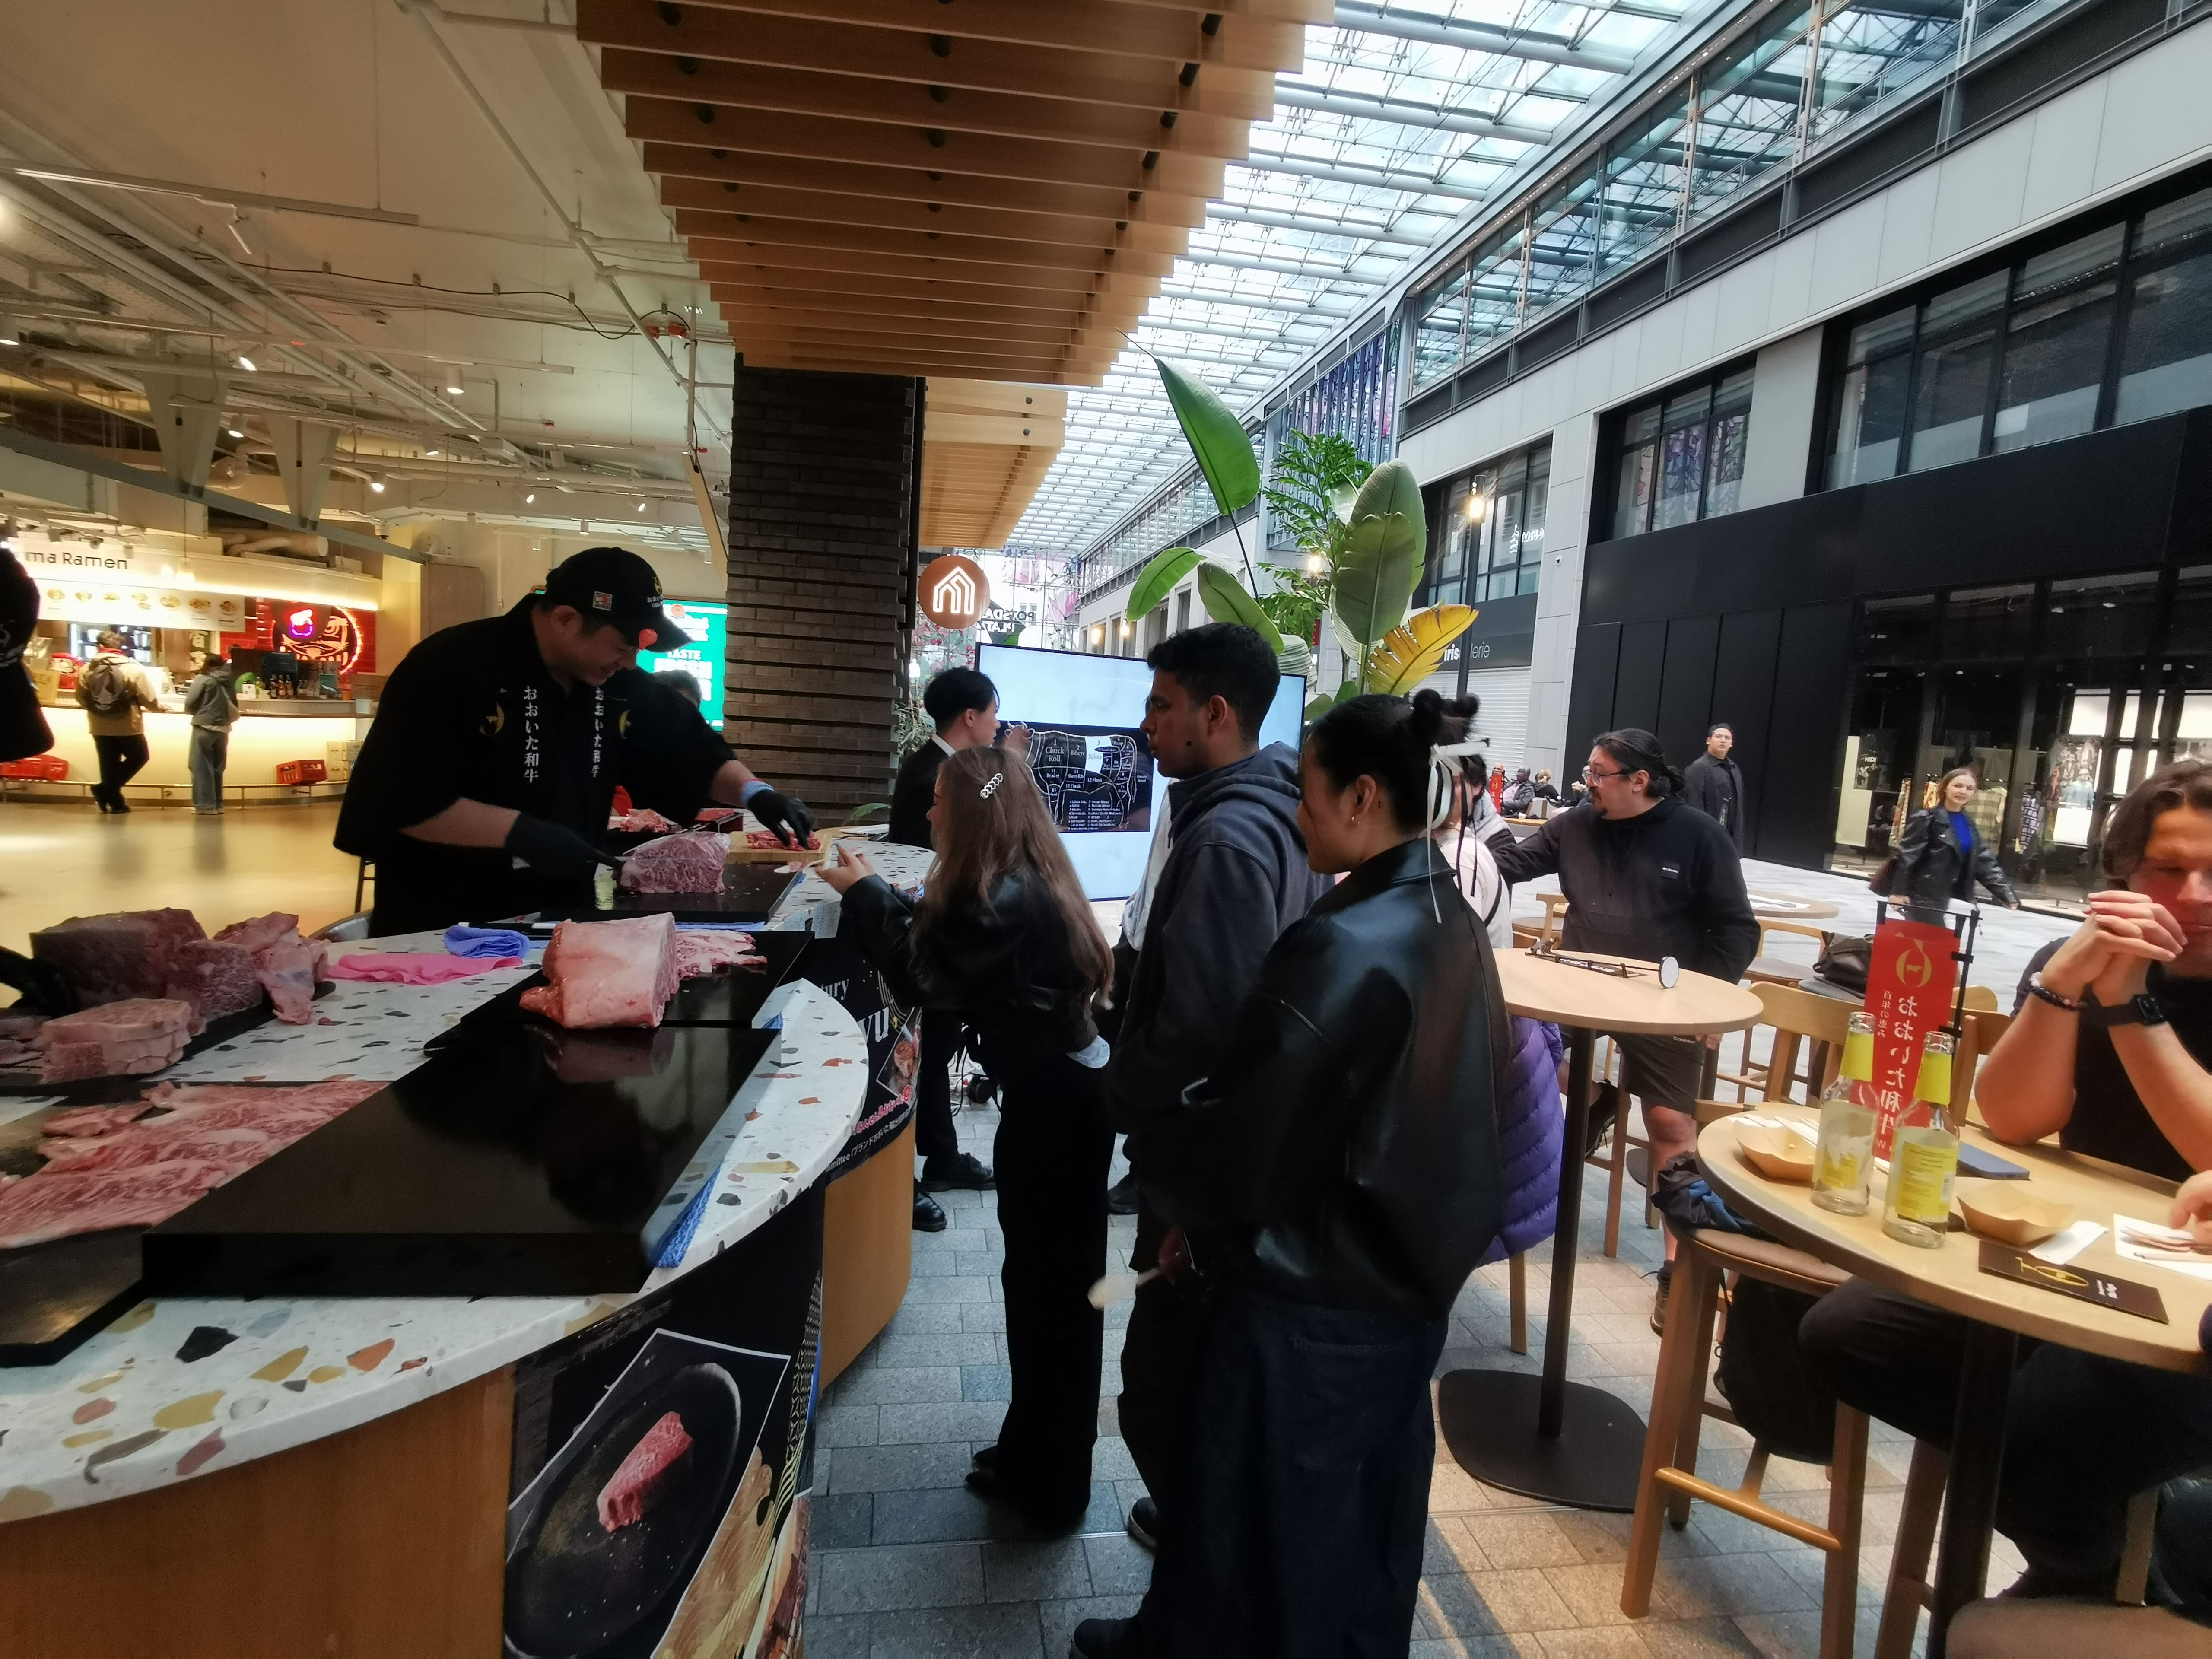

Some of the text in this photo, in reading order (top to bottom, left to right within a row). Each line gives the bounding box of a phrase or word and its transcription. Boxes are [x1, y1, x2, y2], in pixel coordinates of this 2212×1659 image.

[63, 552, 128, 569] Ramen
[524, 686, 539, 783] おおいた和牛
[1045, 747, 1065, 755] Chuck
